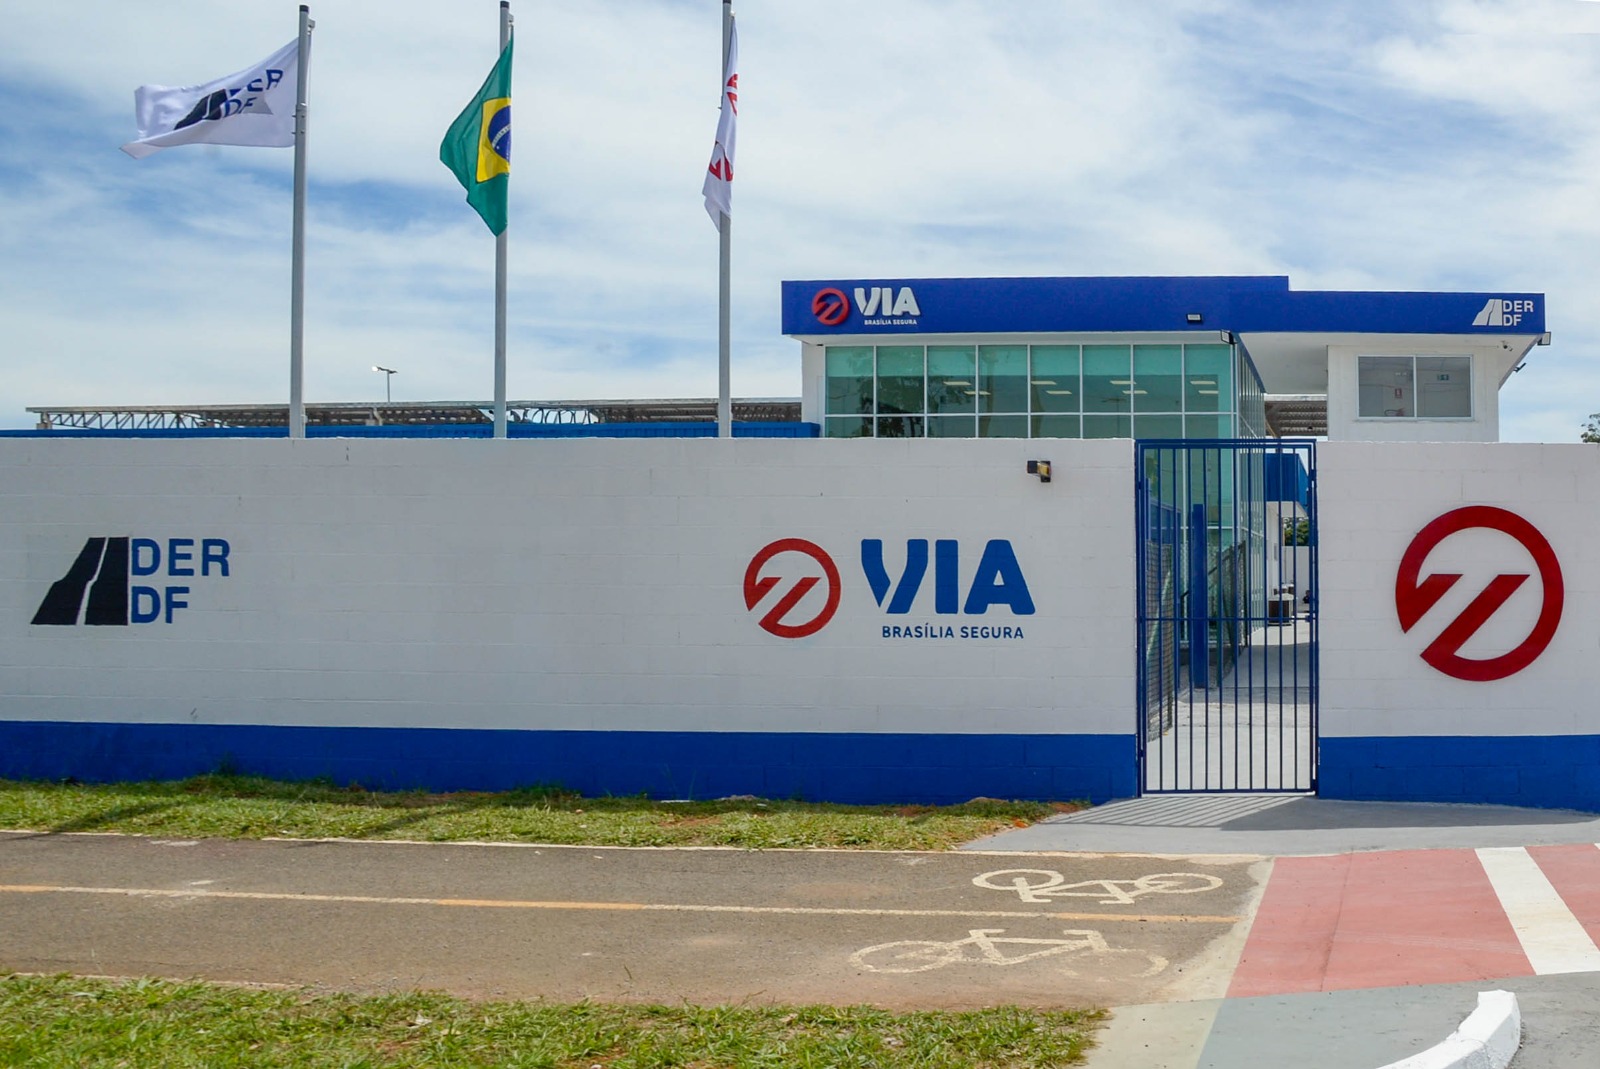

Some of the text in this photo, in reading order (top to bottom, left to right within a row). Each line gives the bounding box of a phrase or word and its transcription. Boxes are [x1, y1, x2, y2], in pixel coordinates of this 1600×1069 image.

[223, 98, 258, 118] DF
[854, 286, 921, 317] VIA
[1502, 300, 1534, 313] DER
[864, 318, 892, 326] BRASÍLIA
[1502, 314, 1522, 327] DF
[131, 538, 230, 577] DER
[861, 539, 1036, 615] VIA
[131, 586, 190, 624] DF
[882, 622, 1024, 640] BRASÍLIA SEGURA
